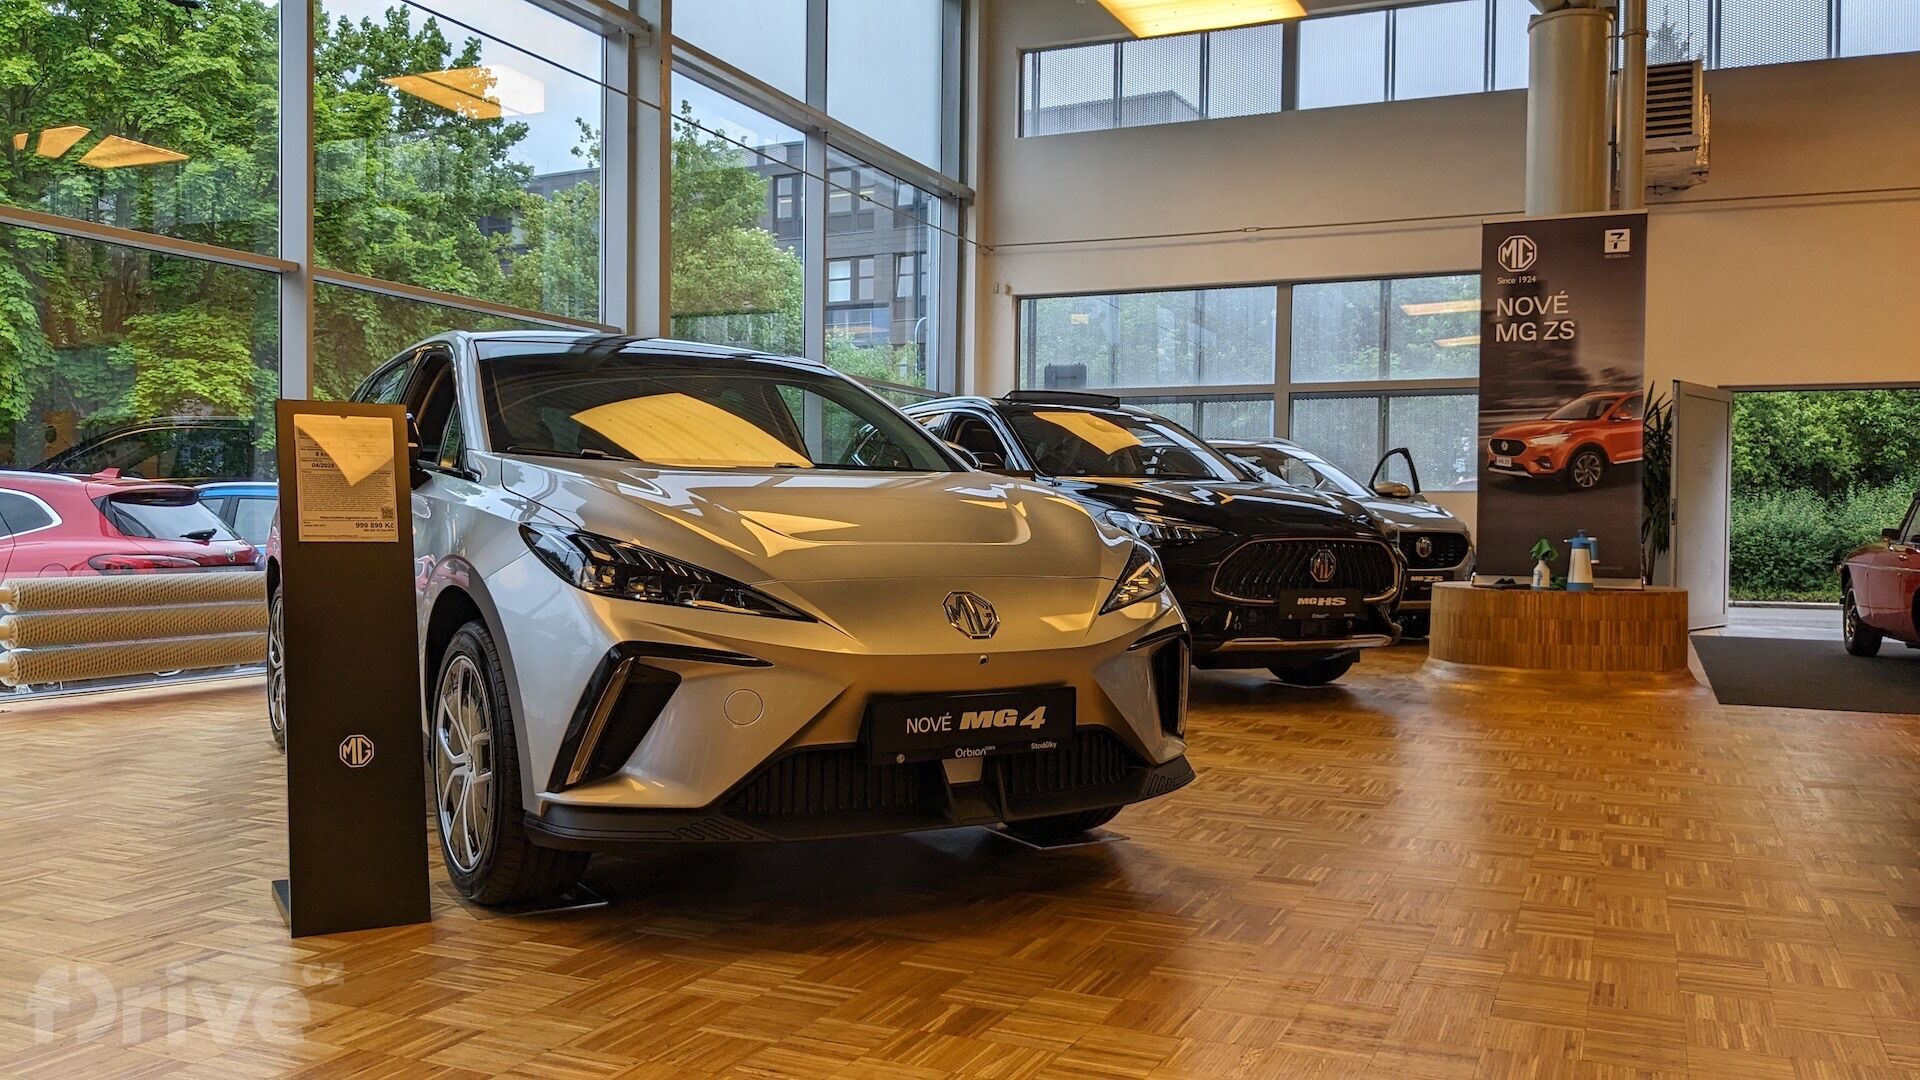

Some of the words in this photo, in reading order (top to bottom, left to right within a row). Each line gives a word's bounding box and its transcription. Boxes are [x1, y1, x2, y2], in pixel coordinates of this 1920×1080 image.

[1500, 237, 1535, 270] MG
[1610, 232, 1624, 249] 7
[1497, 276, 1516, 285] Since
[1518, 275, 1536, 284] 1924
[1496, 290, 1569, 317] NOVÉ
[1495, 322, 1537, 342] MG
[1543, 320, 1576, 341] ZS
[1312, 551, 1335, 580] MG
[945, 592, 998, 637] MG
[906, 712, 953, 735] NOVÉ
[341, 737, 373, 766] MG
